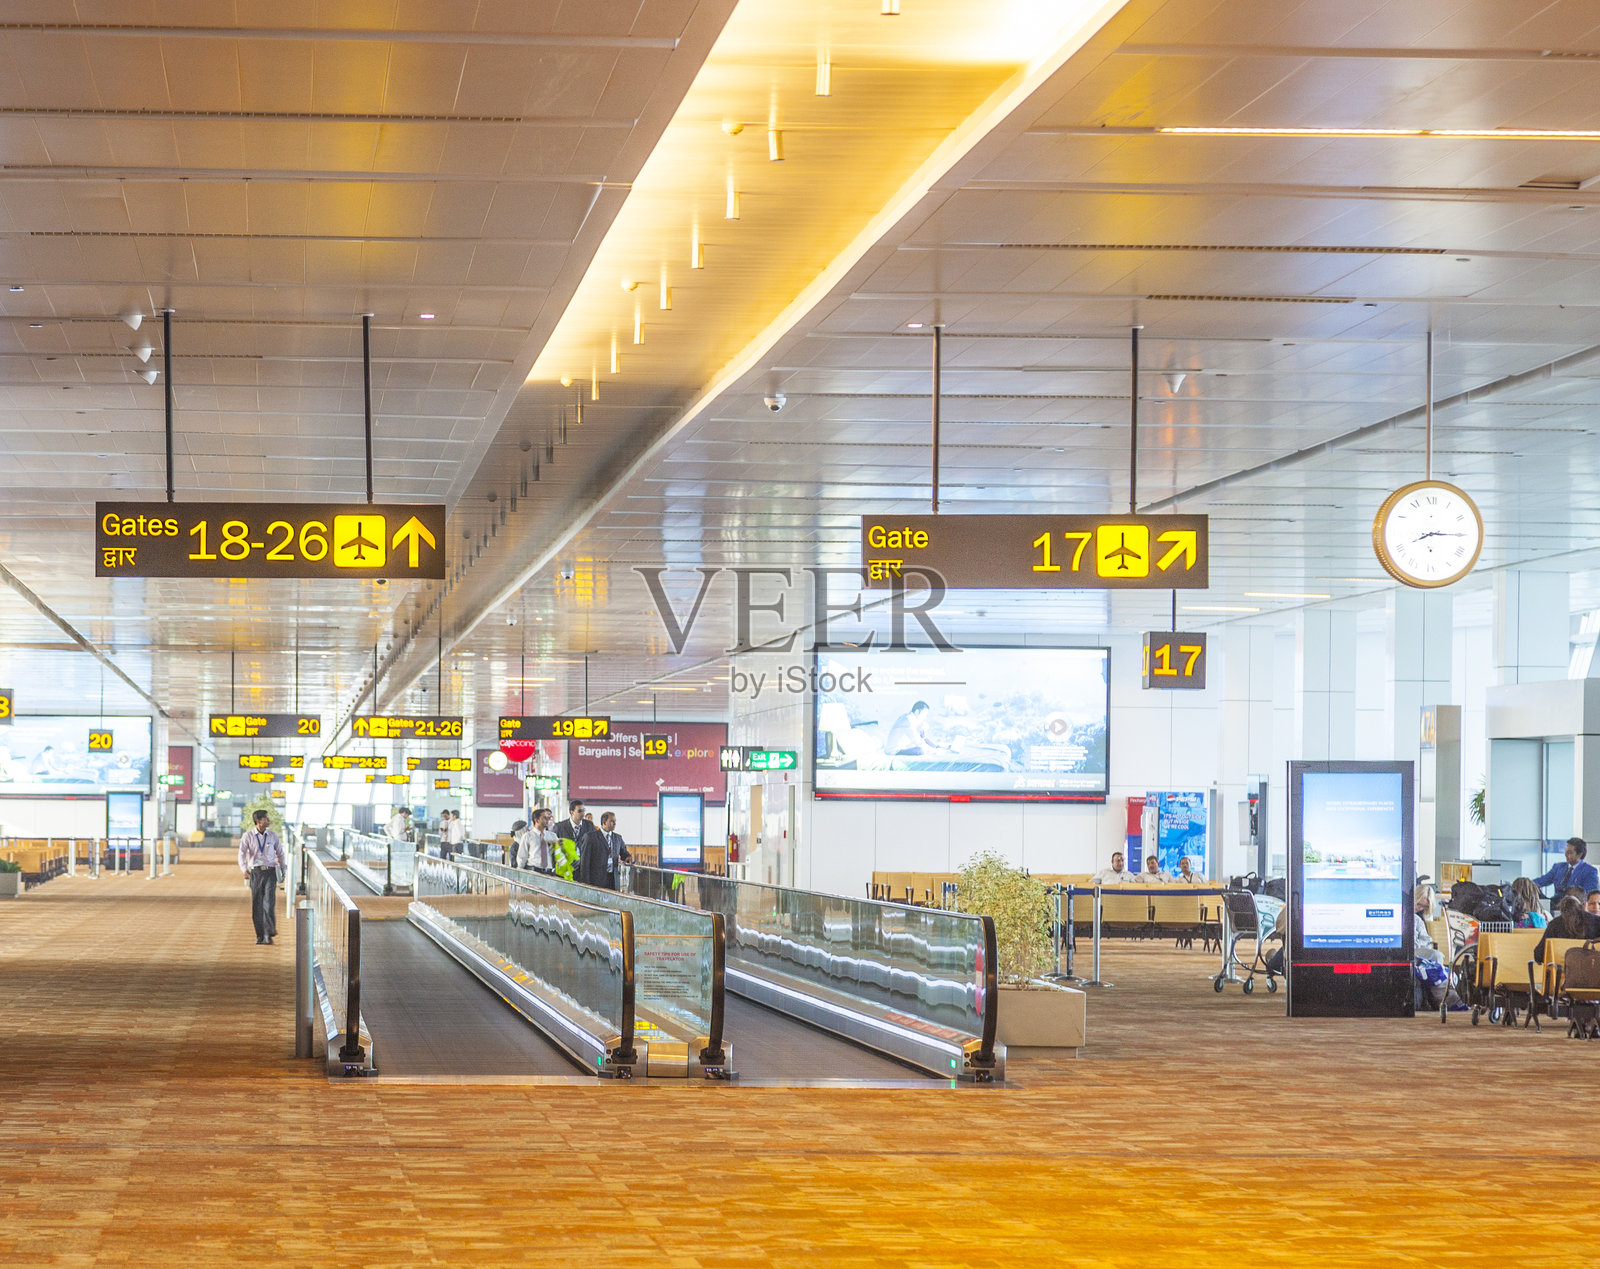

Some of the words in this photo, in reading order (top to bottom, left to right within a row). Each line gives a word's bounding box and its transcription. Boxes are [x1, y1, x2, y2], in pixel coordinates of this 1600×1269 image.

[102, 513, 179, 537] Gates
[188, 520, 330, 561] 18-26
[101, 547, 138, 569] द्वार
[867, 525, 930, 549] Gate
[1032, 528, 1093, 573] 17
[867, 558, 904, 582] द्वार
[1153, 643, 1202, 677] 17
[246, 716, 267, 727] Gate
[297, 718, 320, 735] 20
[388, 717, 415, 729] Gates
[414, 720, 462, 737] 21-26
[499, 718, 522, 729] Gate
[552, 720, 574, 737] 19
[88, 732, 113, 749] 20
[645, 739, 668, 755] 19
[578, 745, 622, 758] Bargains
[674, 747, 715, 759] explore
[289, 756, 304, 768] 22
[436, 759, 450, 770] 21
